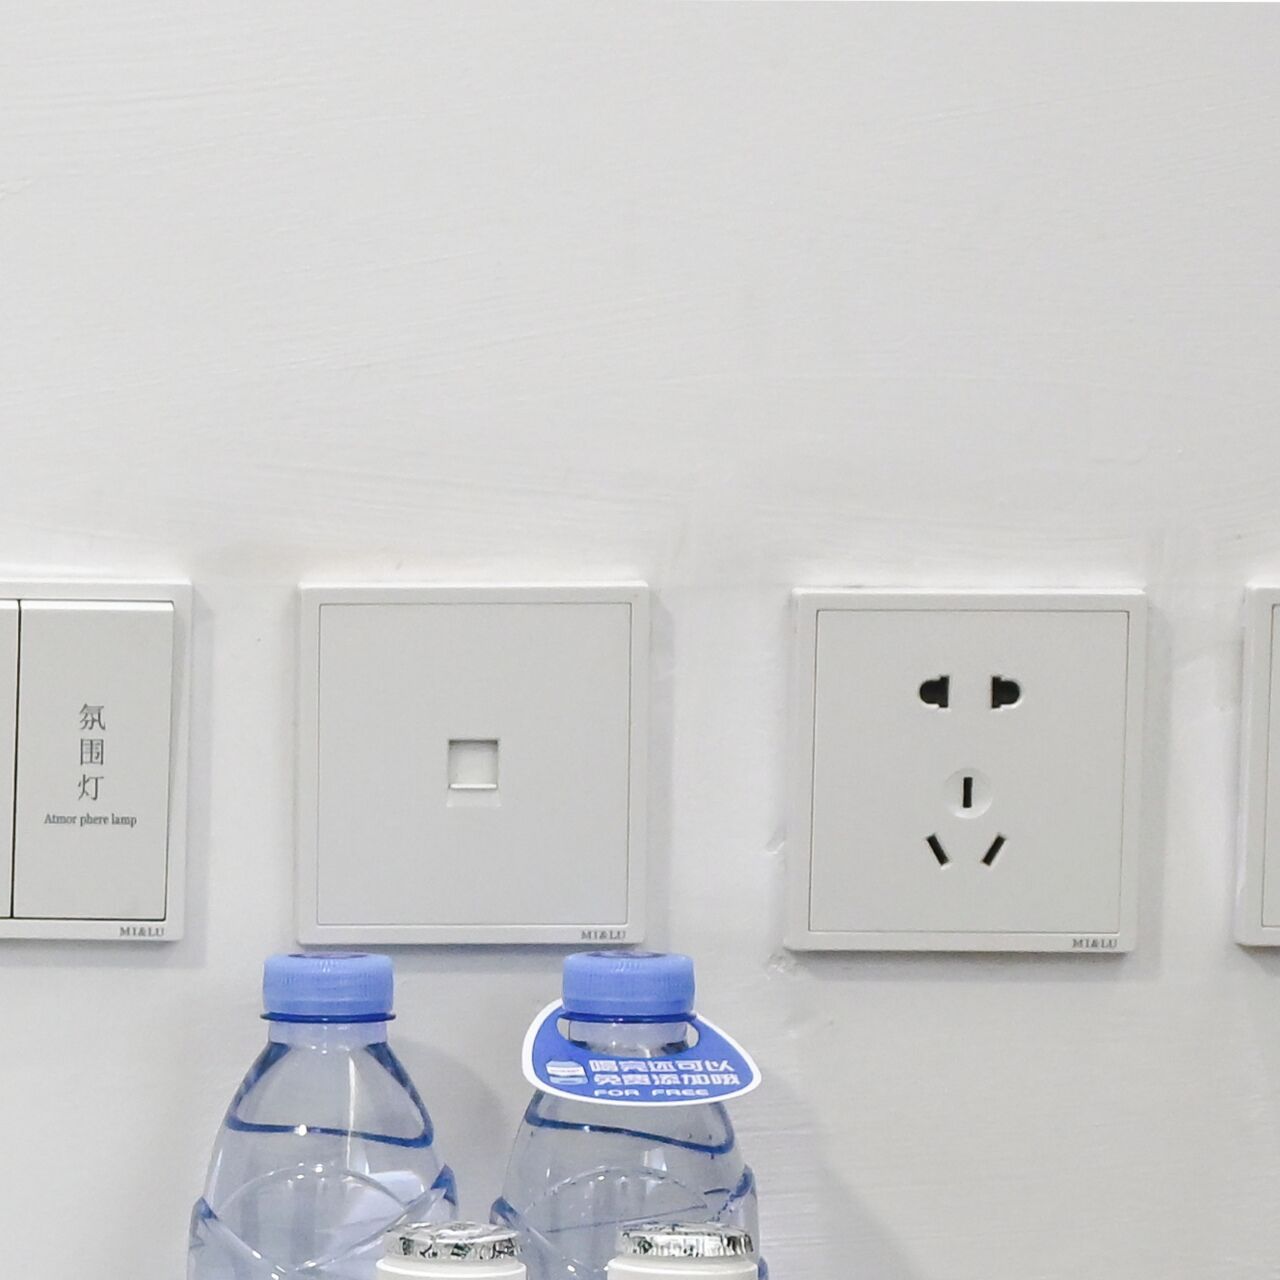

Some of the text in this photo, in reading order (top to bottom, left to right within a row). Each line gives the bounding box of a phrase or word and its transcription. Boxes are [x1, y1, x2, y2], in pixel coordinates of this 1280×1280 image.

[78, 703, 106, 801] 氛围灯
[111, 813, 137, 828] lamp
